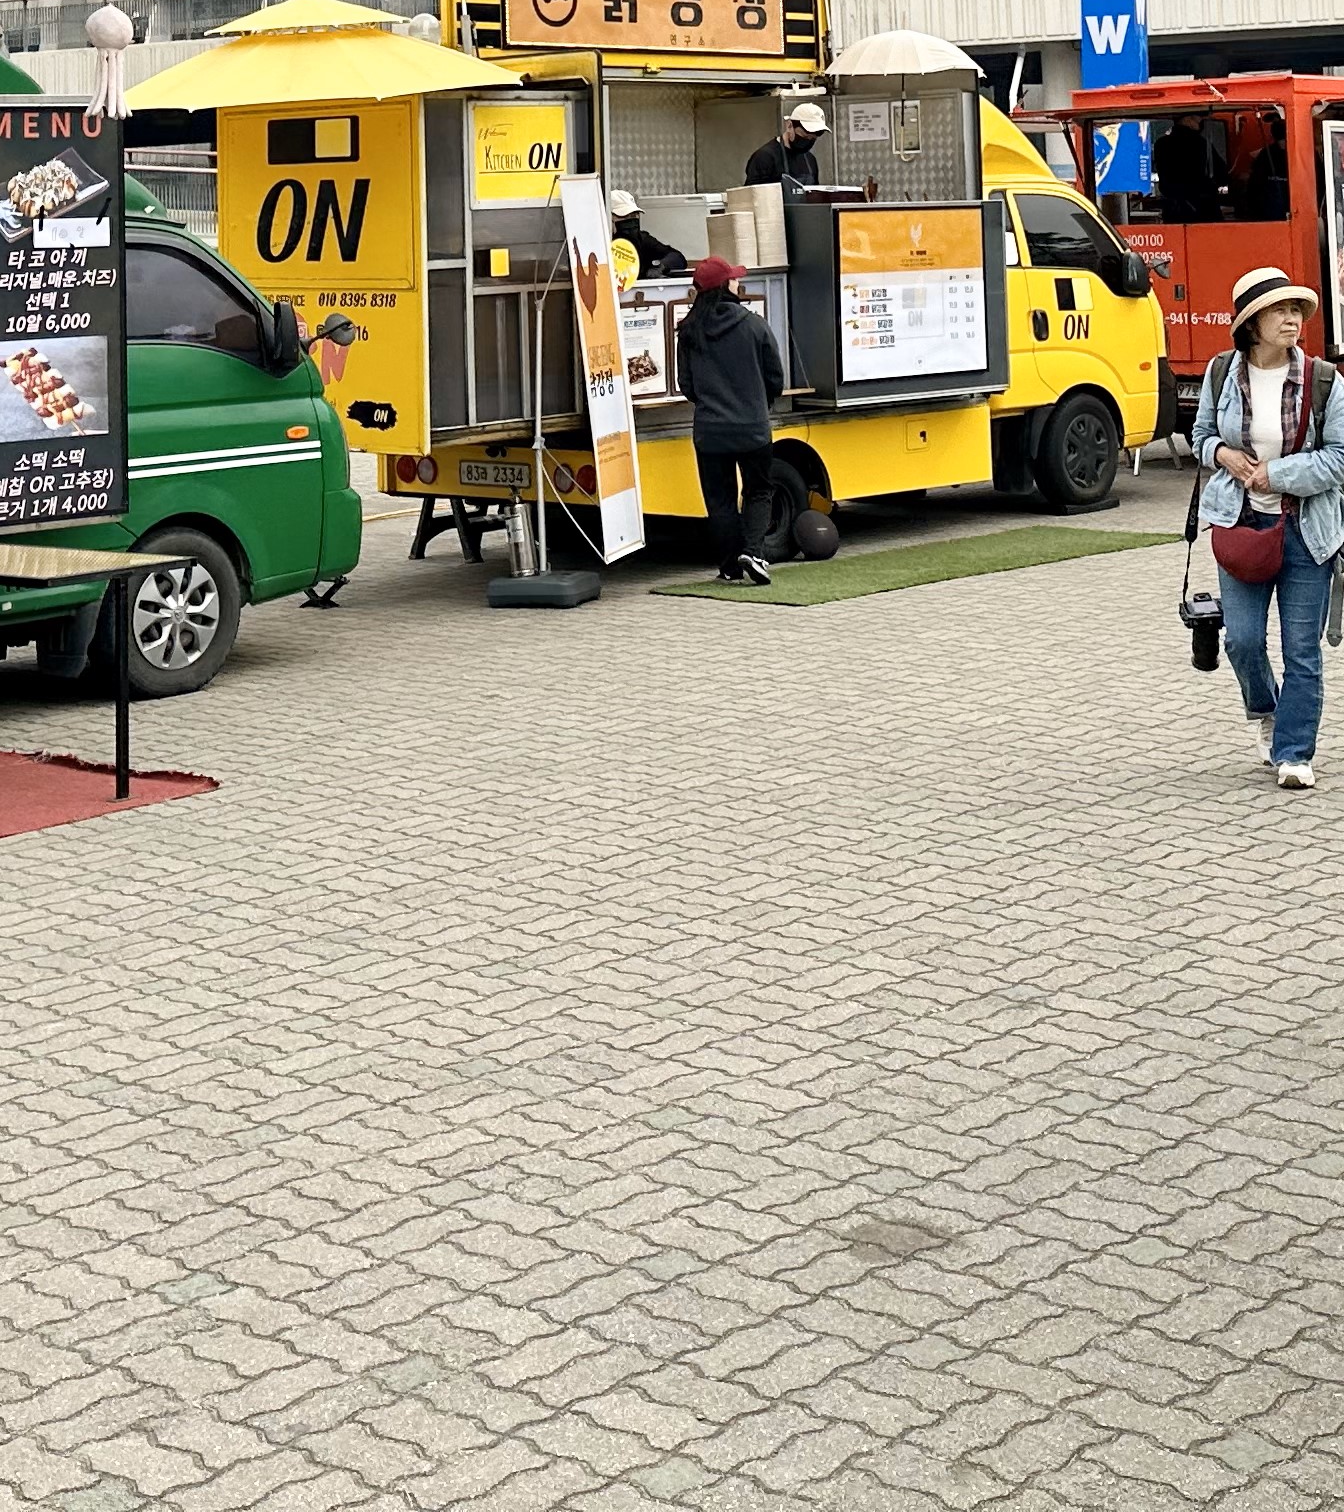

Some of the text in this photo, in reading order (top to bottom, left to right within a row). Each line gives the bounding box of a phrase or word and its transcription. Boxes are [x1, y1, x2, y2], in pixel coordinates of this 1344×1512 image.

[1085, 14, 1130, 54] W
[528, 142, 562, 170] ON
[256, 178, 371, 263] ON
[8, 247, 87, 269] 타코야끼
[26, 292, 70, 311] 선택 1
[318, 292, 337, 307] 010
[339, 292, 367, 308] 8395
[370, 292, 397, 308] 8318
[6, 312, 91, 334] 10알 6,000
[1064, 314, 1090, 340] ON
[374, 409, 388, 422] ON
[13, 448, 85, 472] 소떡 소떡
[29, 475, 55, 494] OR
[58, 468, 114, 491] 고추장)
[493, 466, 524, 483] 2334
[30, 496, 58, 517] 1개
[61, 493, 108, 514] 4,000
